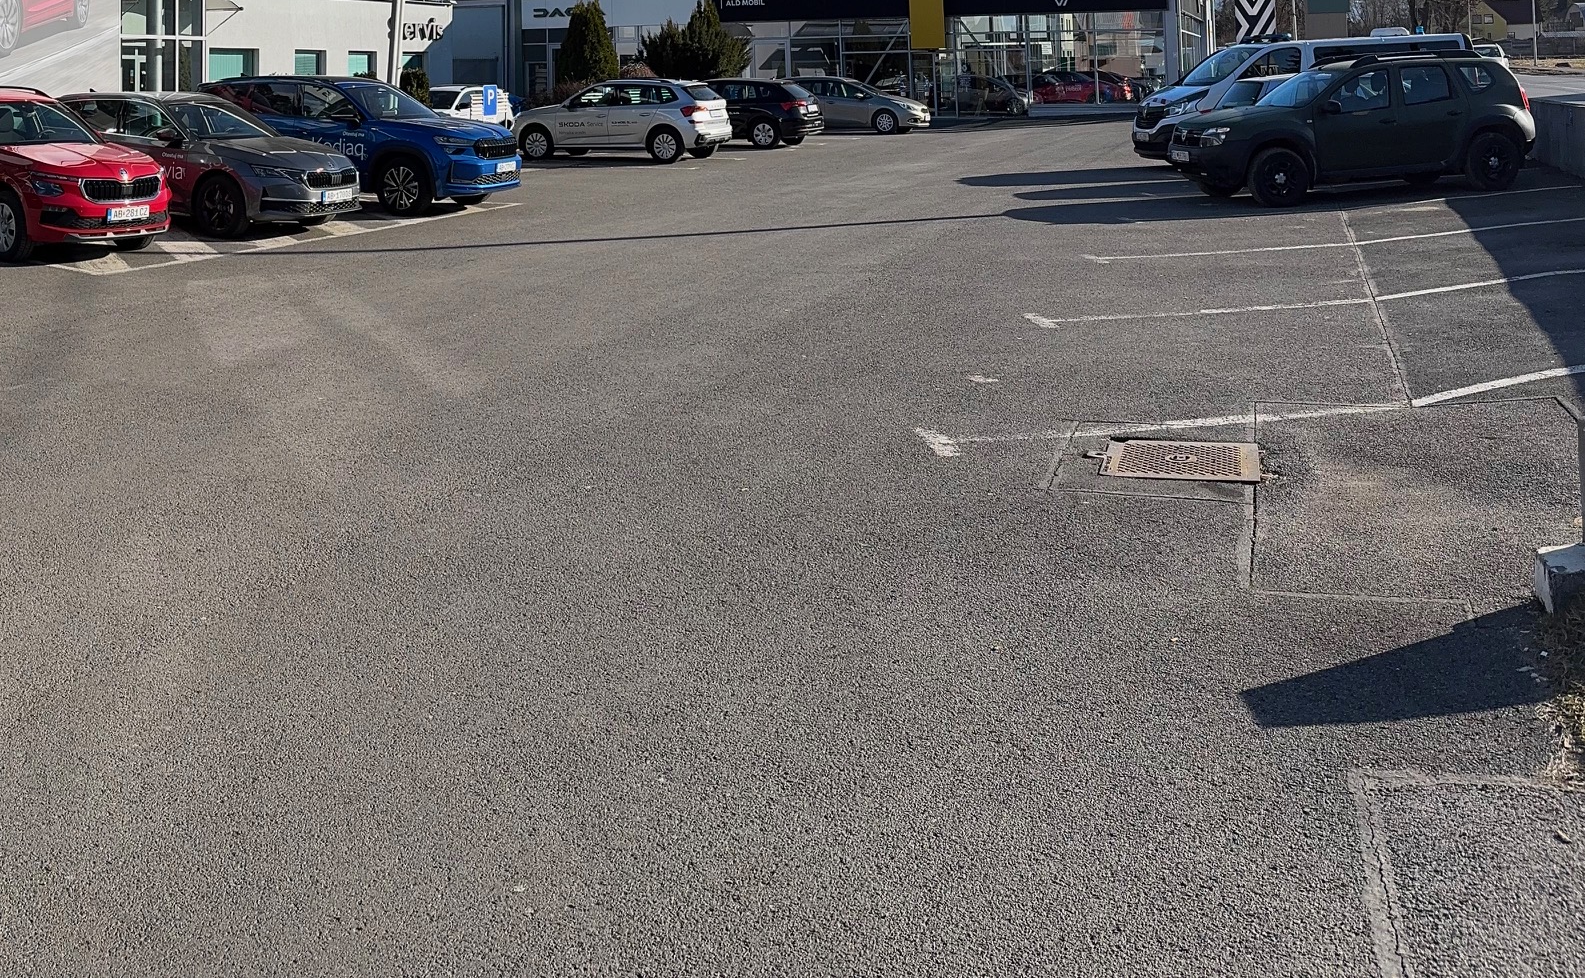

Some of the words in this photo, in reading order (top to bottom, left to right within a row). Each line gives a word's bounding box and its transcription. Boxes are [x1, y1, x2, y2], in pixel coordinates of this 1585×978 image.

[726, 0, 741, 7] ALD
[402, 17, 444, 40] ervis
[487, 89, 495, 106] P
